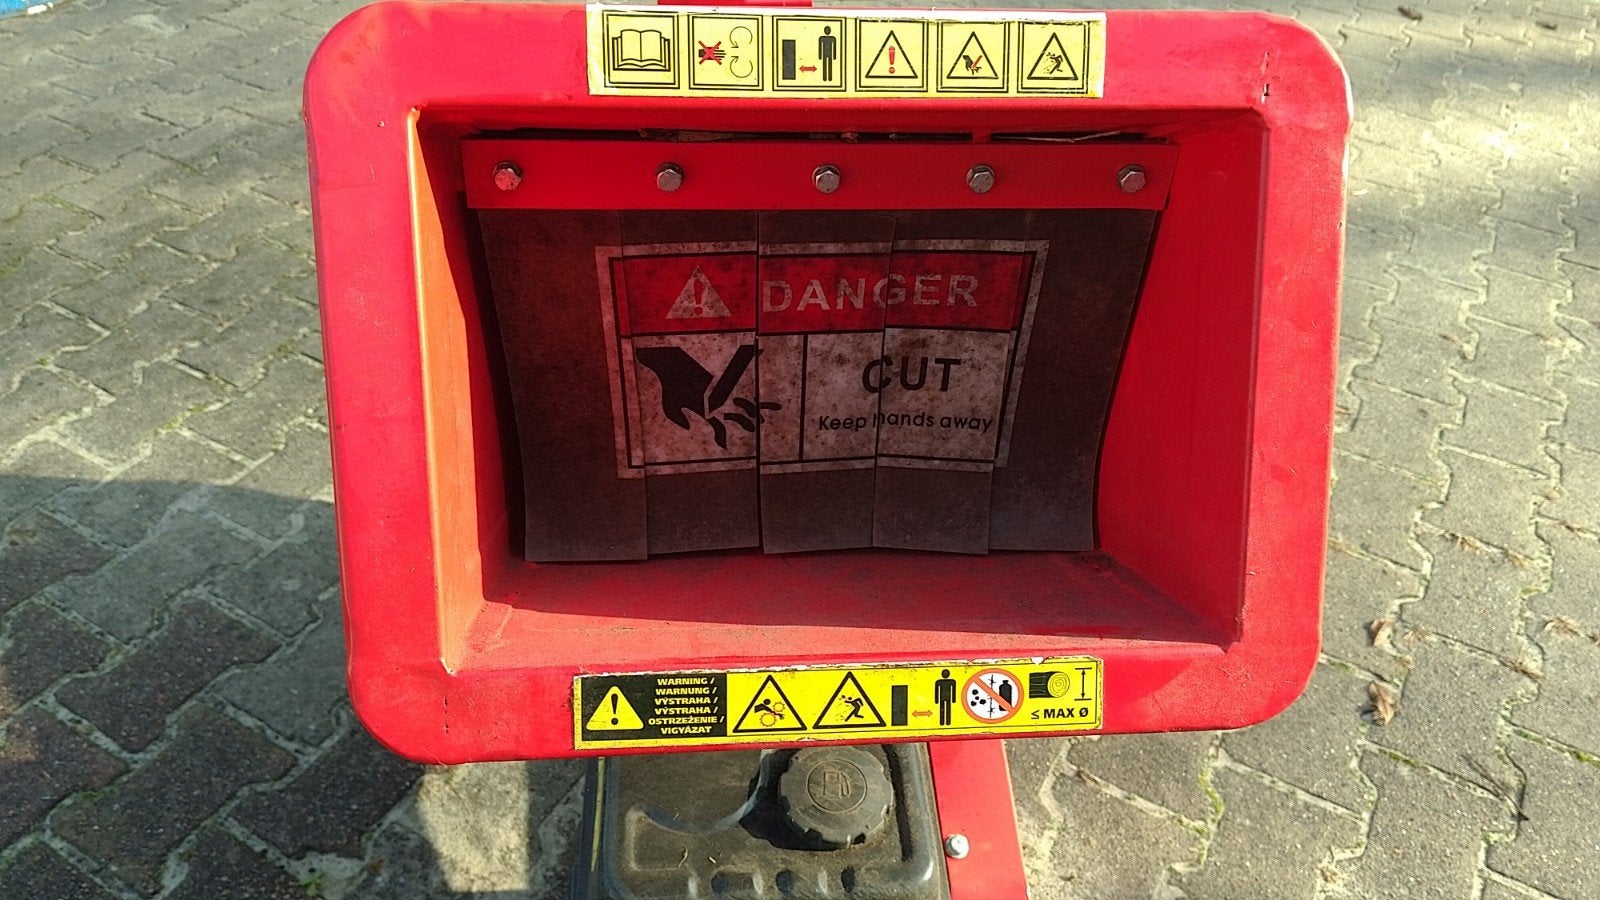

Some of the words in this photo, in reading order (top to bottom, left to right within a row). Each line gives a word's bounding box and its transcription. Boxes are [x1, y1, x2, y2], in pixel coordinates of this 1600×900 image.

[762, 273, 980, 312] DANGER
[861, 355, 961, 393] CUT
[818, 415, 867, 432] Keep
[939, 416, 993, 433] away
[657, 677, 708, 686] WARNING
[655, 687, 710, 695] WARNUNG
[654, 696, 711, 705] VÝSTRAHA
[1043, 708, 1075, 719] MAX
[648, 715, 717, 725] OSTRZEŻENIE
[660, 725, 712, 734] VIGYÁZAT
